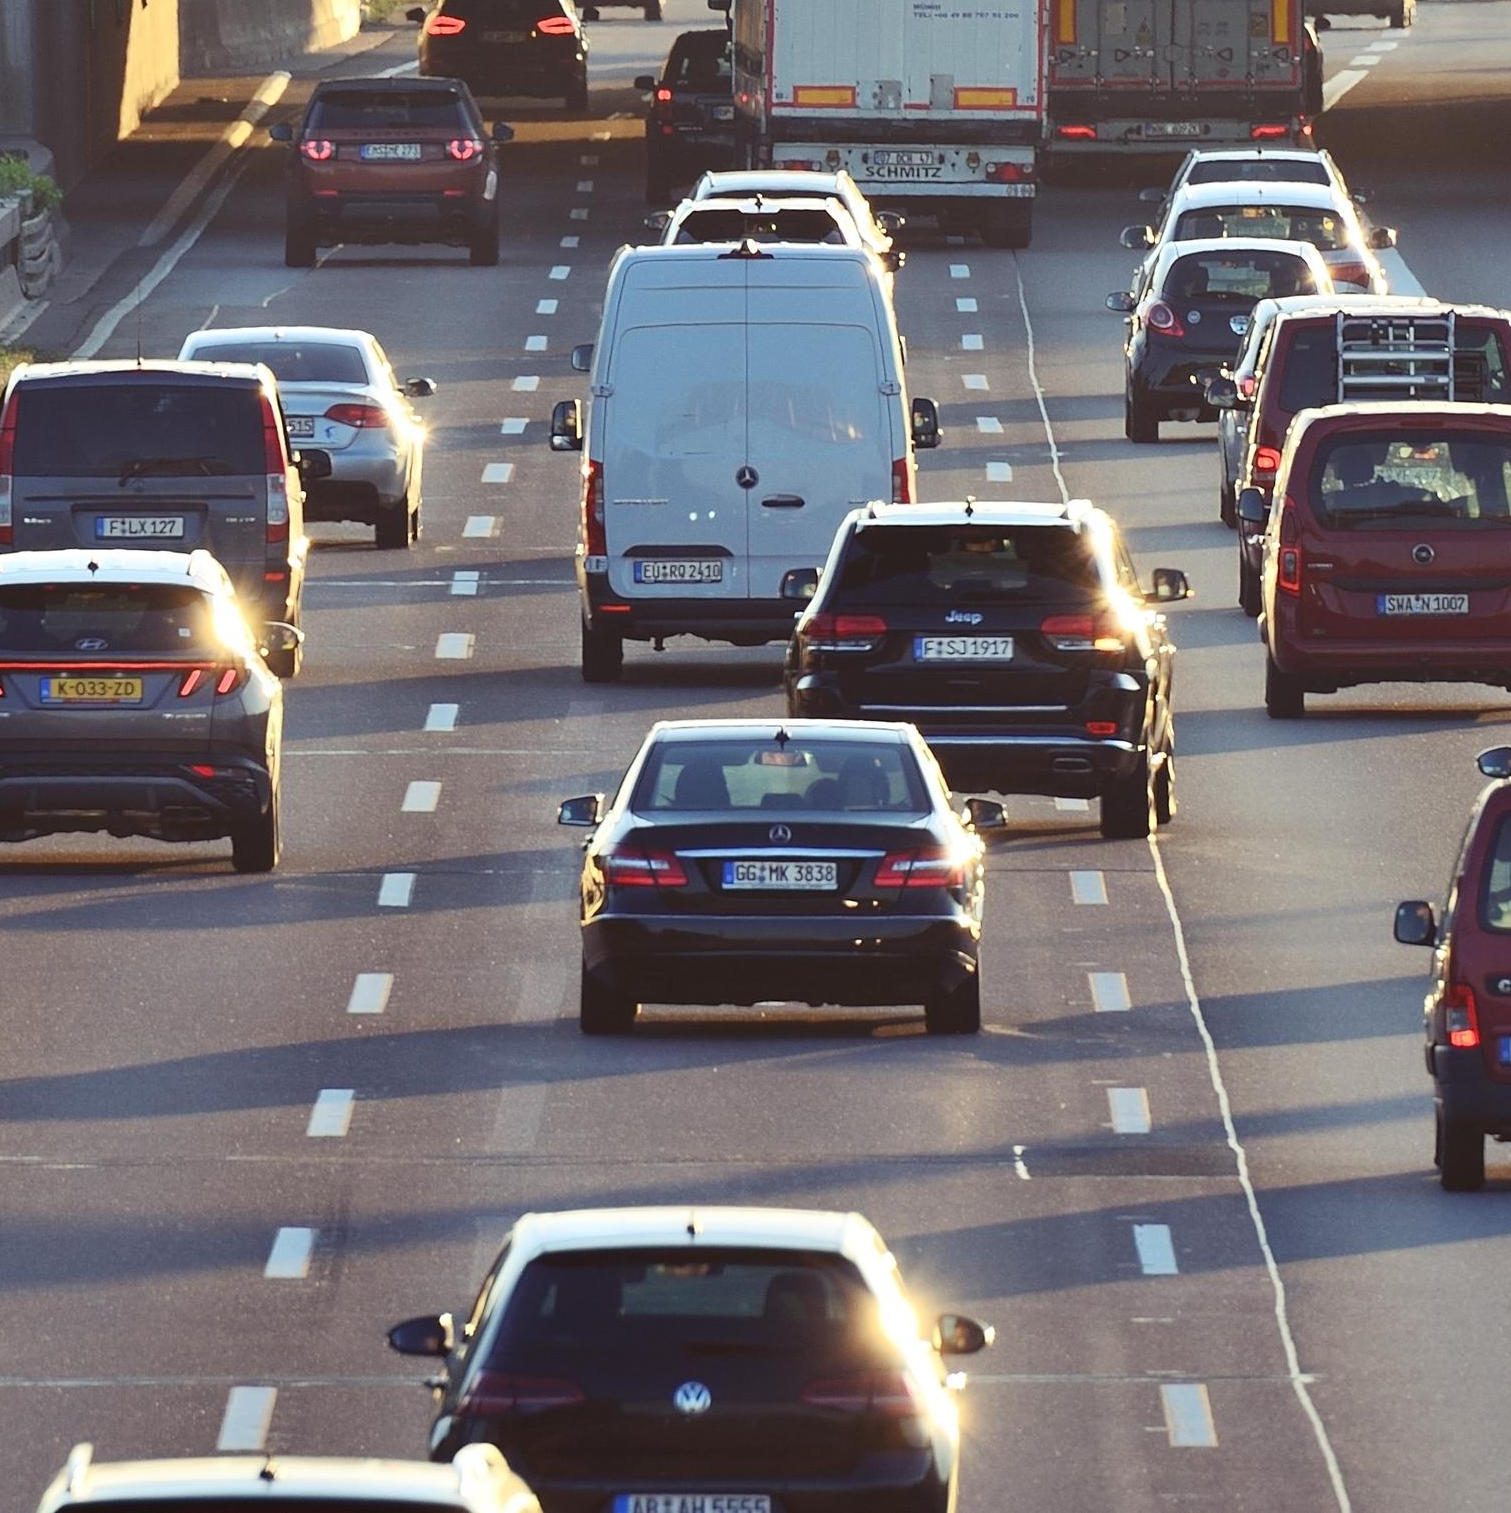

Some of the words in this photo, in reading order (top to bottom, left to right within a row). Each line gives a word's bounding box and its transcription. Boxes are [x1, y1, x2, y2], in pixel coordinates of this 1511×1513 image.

[865, 167, 942, 178] SCHMITZ
[129, 519, 147, 534] LX
[150, 519, 176, 534] 127
[643, 564, 661, 579] EU
[688, 564, 720, 579] 2410
[1421, 597, 1431, 610] N
[1433, 596, 1466, 611] 1007
[945, 610, 984, 625] Jeep
[924, 640, 935, 656] F
[946, 640, 967, 655] SJ
[970, 640, 1010, 655] 1917
[57, 681, 135, 696] K-033-ZD
[736, 864, 756, 881] GG
[794, 865, 834, 882] 3838
